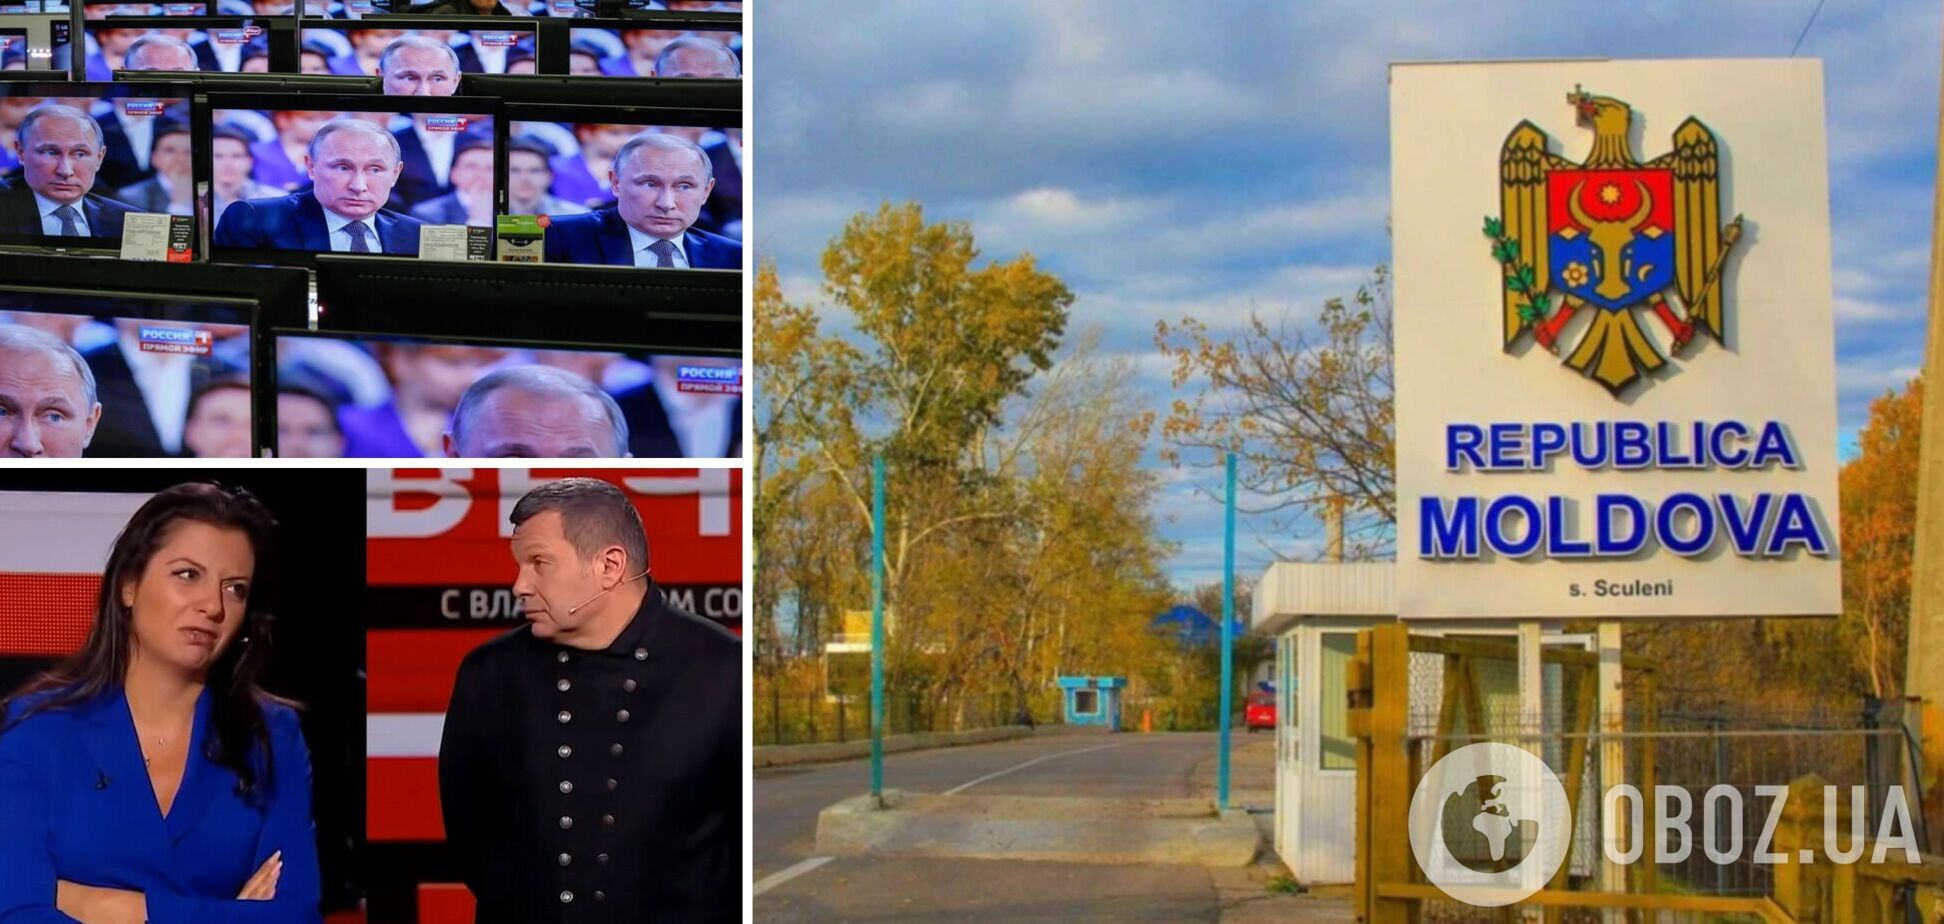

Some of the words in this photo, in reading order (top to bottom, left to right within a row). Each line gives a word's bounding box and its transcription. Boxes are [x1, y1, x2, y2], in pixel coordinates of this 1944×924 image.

[142, 328, 191, 341] РОССИЯ
[142, 342, 180, 353] ПРЯМОЙ
[181, 345, 209, 354] ЭФИР
[681, 366, 734, 379] РОССИЯ
[1445, 420, 1798, 470] REPUBLICA
[1418, 492, 1830, 558] MOLDOVA
[1569, 583, 1587, 597] s.
[1594, 579, 1673, 597] Sculeni
